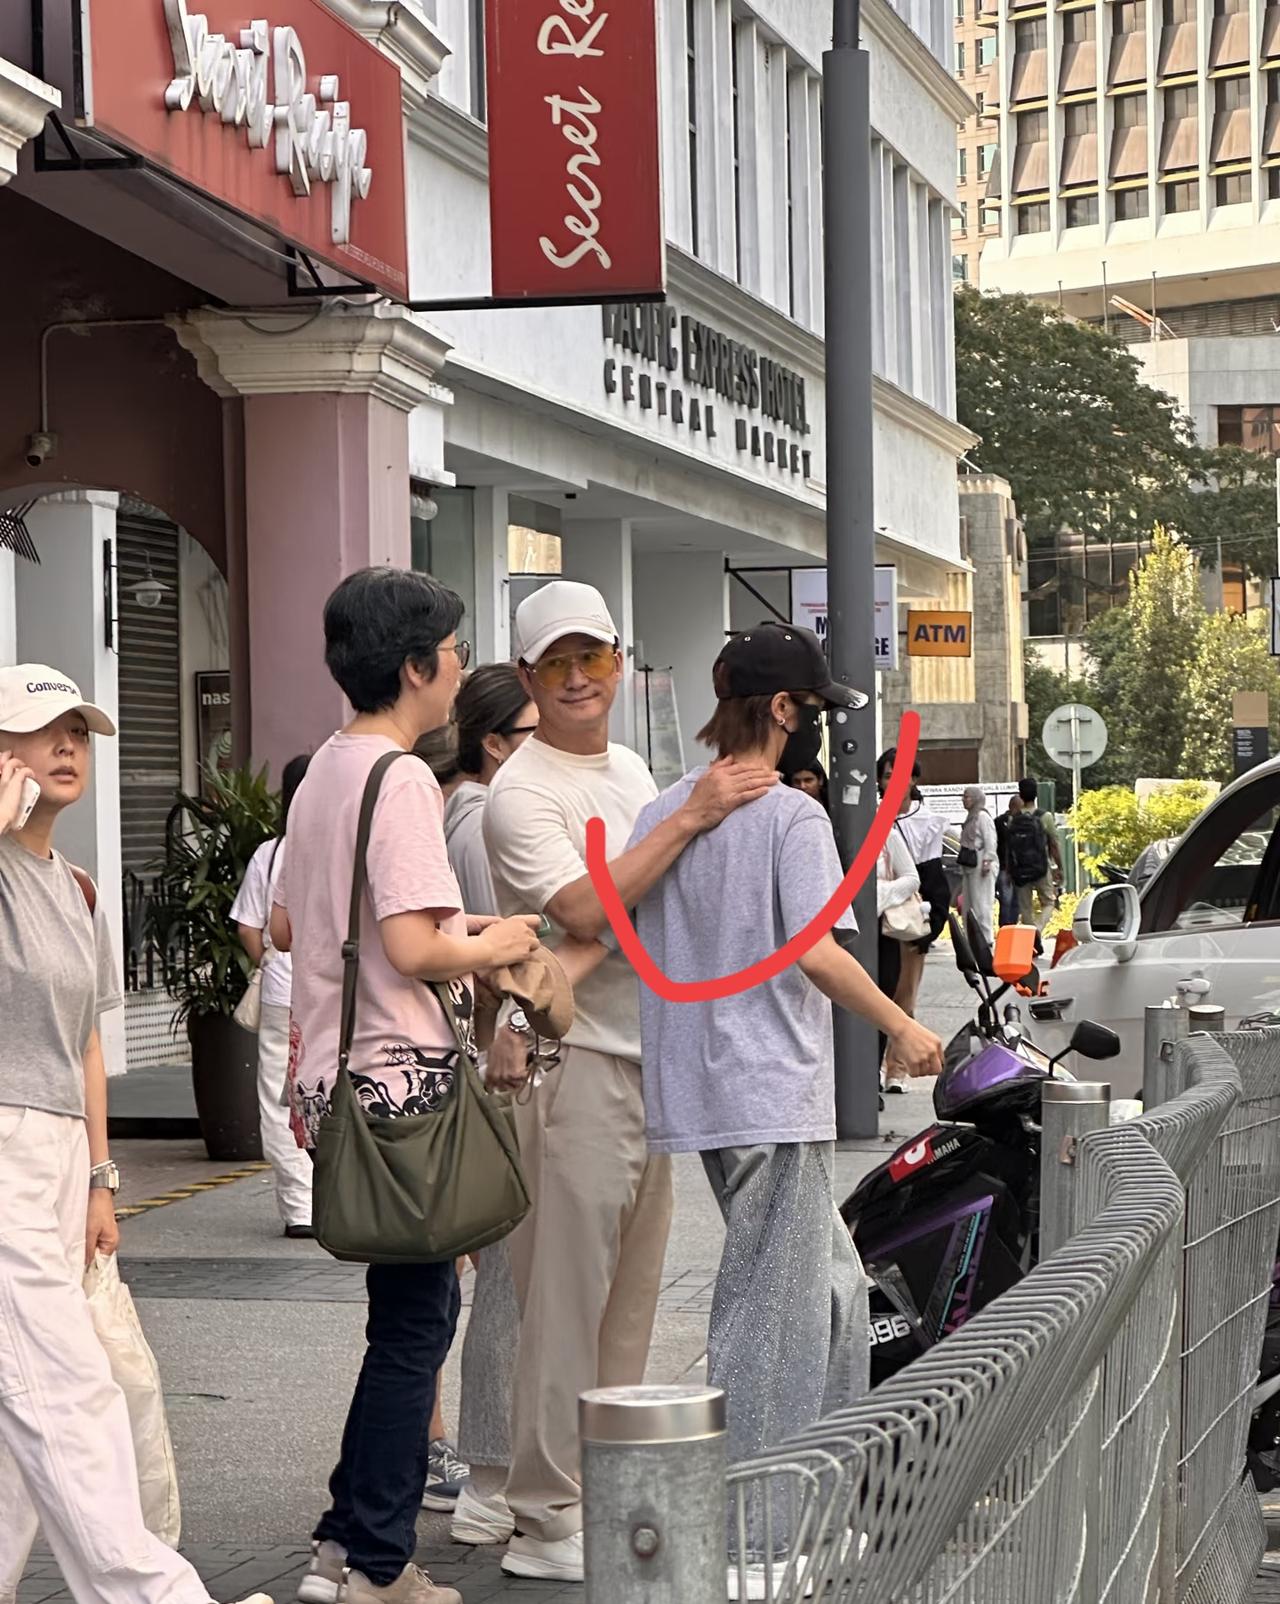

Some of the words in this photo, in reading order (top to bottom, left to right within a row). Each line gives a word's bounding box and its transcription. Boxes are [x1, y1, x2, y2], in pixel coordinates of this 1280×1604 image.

[538, 85, 612, 270] Secret
[604, 358, 718, 438] CENTRAL
[735, 418, 812, 478] MARKET
[681, 315, 760, 410] EXPRESS
[759, 356, 811, 435] HOTEL
[913, 624, 967, 643] ATM
[921, 1137, 962, 1165] MAHA
